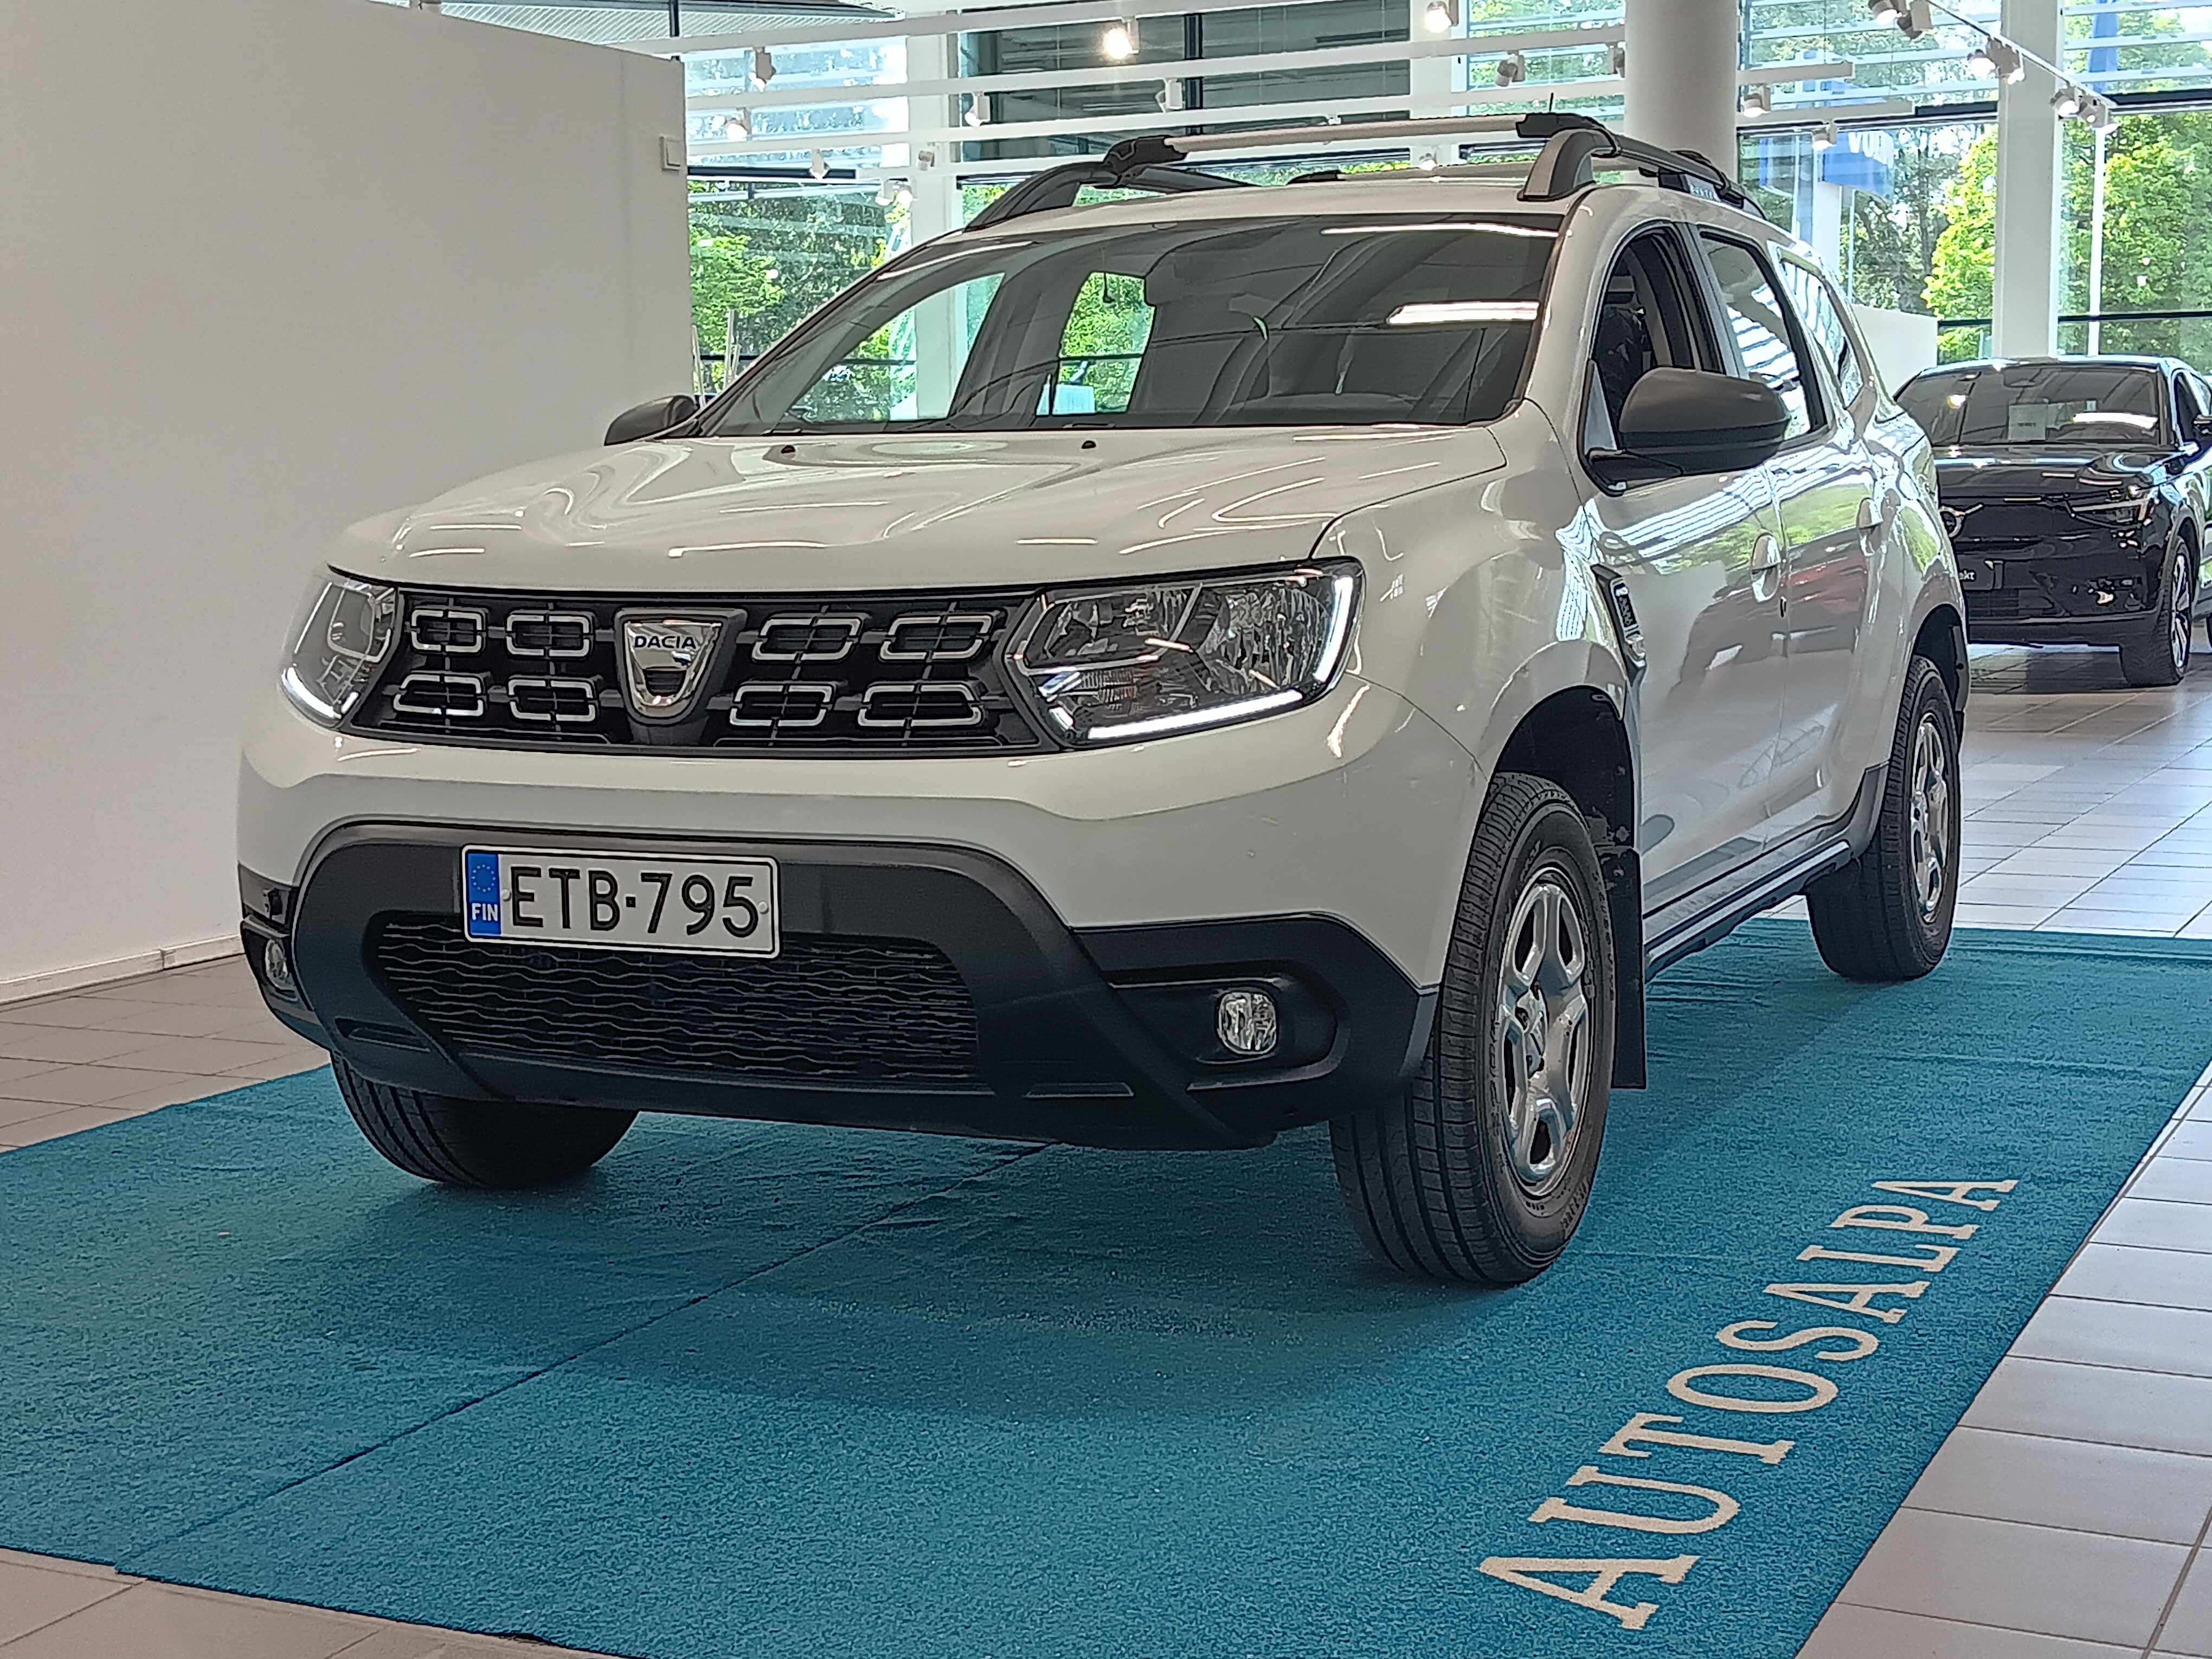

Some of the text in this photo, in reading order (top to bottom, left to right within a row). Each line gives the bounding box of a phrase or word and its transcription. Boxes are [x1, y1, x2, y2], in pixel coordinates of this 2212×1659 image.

[634, 635, 696, 650] DACIA
[471, 902, 498, 922] FIN
[510, 866, 759, 938] ETB-795
[1476, 1179, 2019, 1630] AUTOSALPA
